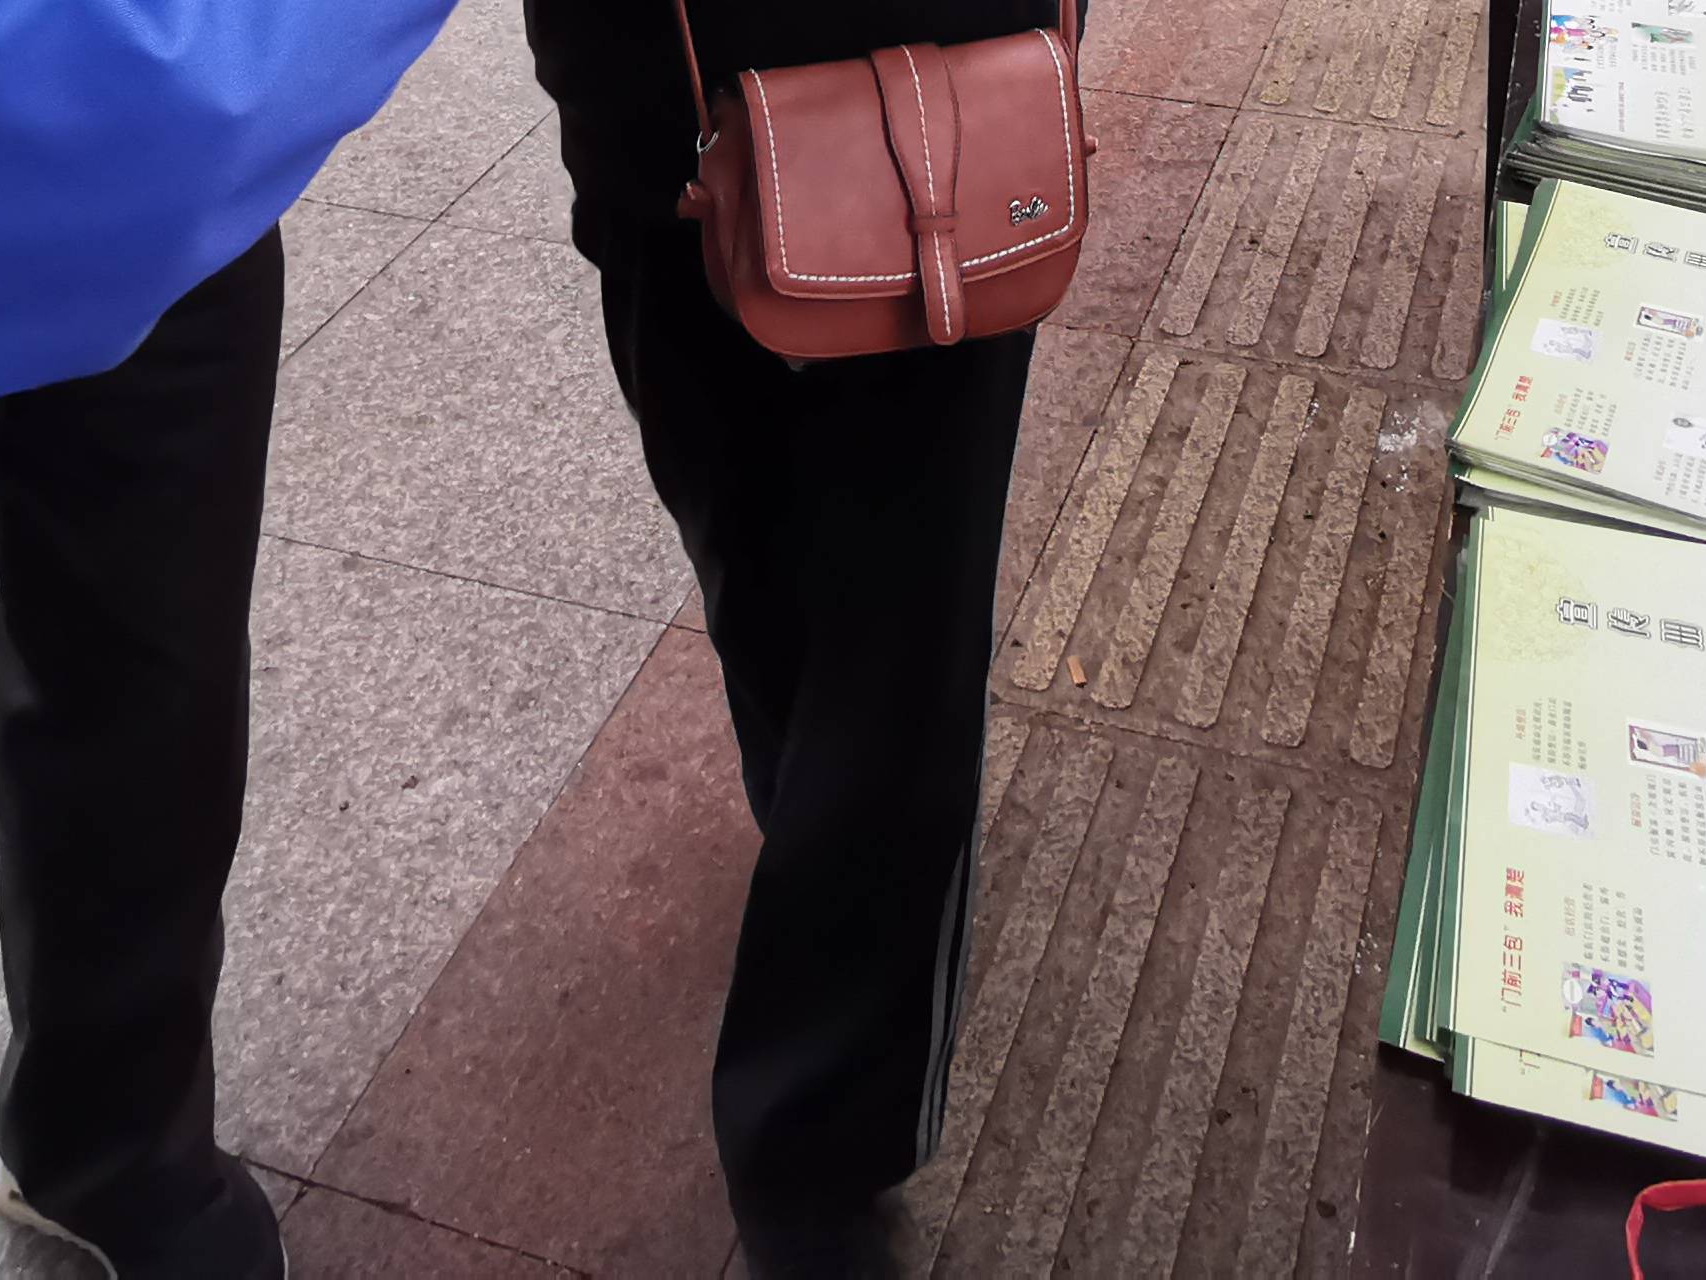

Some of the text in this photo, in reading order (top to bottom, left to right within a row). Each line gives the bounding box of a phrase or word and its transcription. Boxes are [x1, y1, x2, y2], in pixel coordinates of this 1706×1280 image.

[1557, 596, 1705, 651] 宣传册
[1503, 866, 1524, 918] 我清楚
